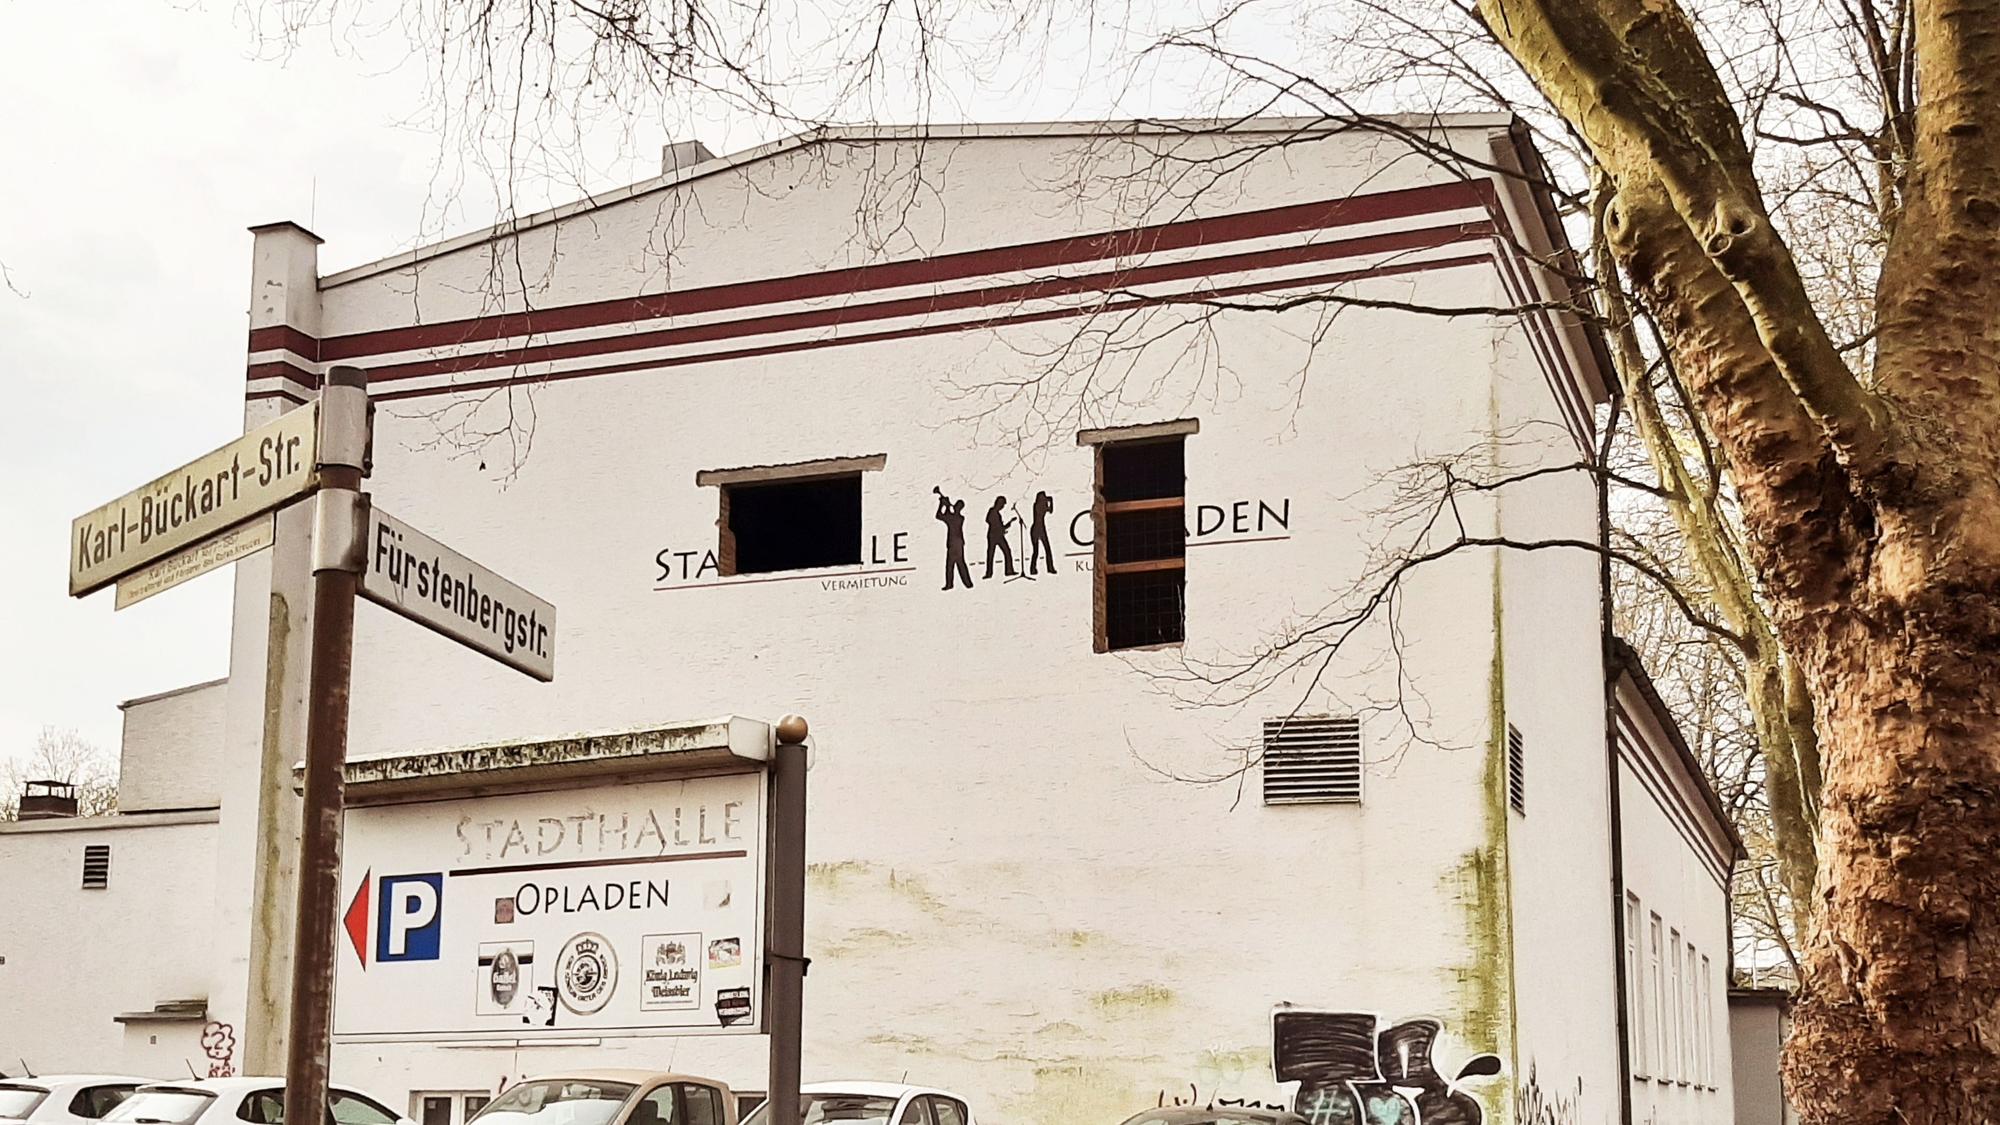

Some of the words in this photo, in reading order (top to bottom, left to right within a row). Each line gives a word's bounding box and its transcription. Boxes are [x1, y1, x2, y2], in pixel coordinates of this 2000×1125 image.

[78, 430, 301, 573] Karl-Bückart-Str.
[375, 521, 548, 659] Fürstenbergstr.
[821, 575, 908, 591] VERMIETUNG
[456, 801, 743, 863] STADTHALLE
[389, 881, 437, 955] P
[515, 879, 670, 915] OPLADEN
